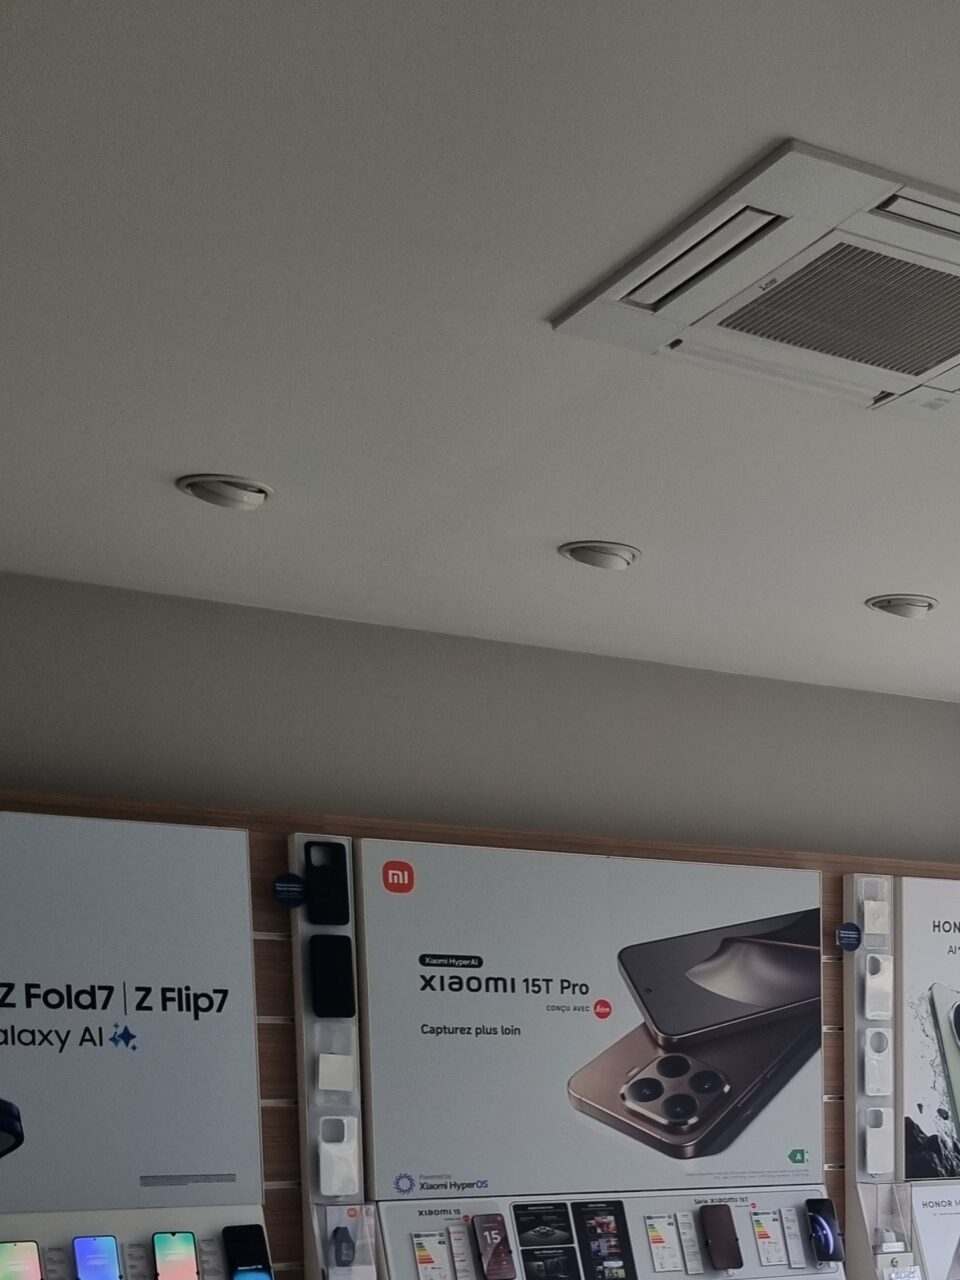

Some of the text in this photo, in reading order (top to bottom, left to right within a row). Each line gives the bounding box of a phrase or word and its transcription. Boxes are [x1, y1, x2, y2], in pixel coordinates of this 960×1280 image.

[522, 978, 554, 994] 15T
[559, 979, 589, 995] Pro
[0, 982, 229, 1021] Z Fold7 Z Flip7
[79, 1026, 103, 1047] AI
[421, 1023, 521, 1037] Capturez plus loin
[419, 1179, 489, 1191] Xiaomi HyperOS
[921, 1200, 953, 1209] HONOR
[483, 1230, 501, 1244] 15
